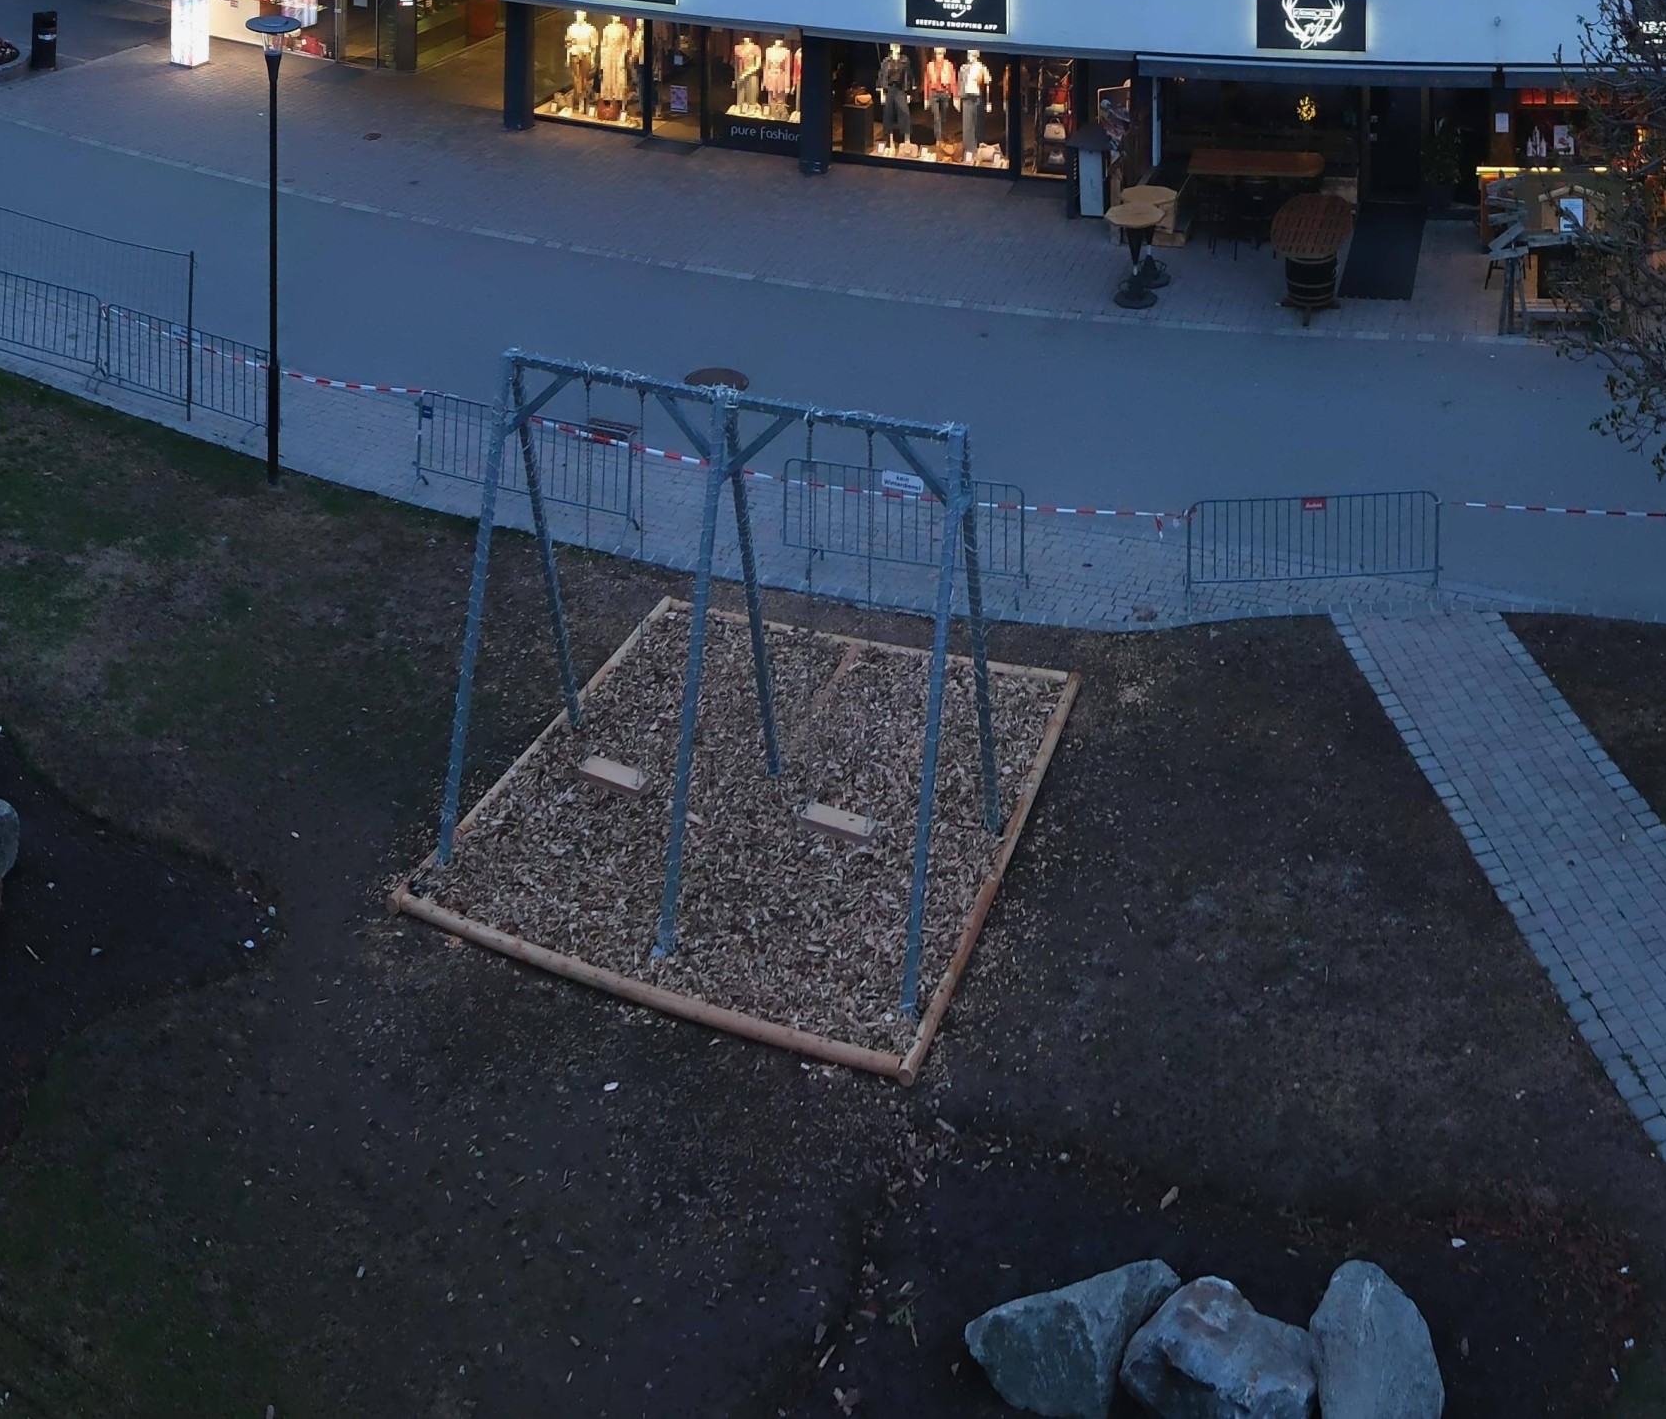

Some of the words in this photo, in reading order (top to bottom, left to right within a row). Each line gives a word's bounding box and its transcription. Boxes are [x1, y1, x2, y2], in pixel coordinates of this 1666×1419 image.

[943, 3, 972, 11] SEEFELD
[915, 18, 945, 27] SEEFELD
[946, 21, 982, 30] SHOPPING
[730, 125, 756, 136] pure
